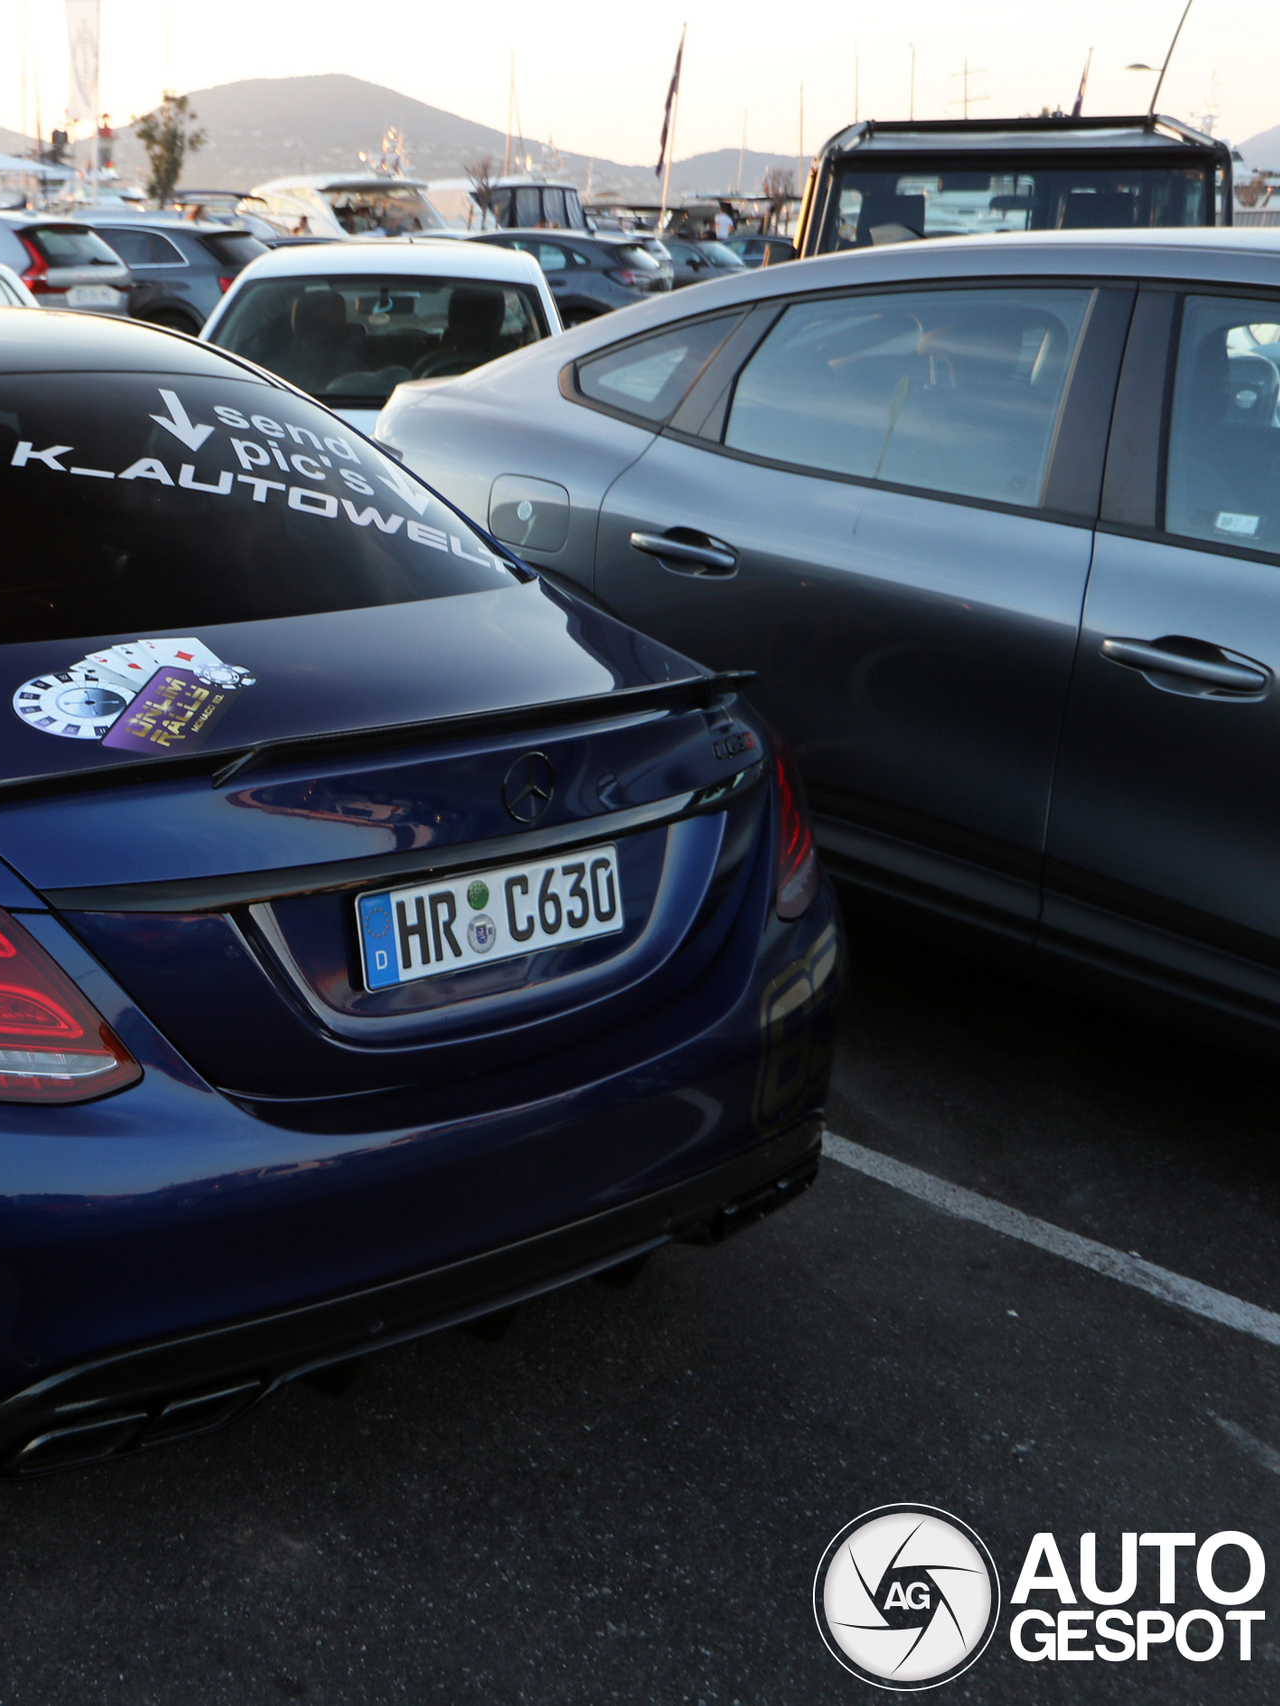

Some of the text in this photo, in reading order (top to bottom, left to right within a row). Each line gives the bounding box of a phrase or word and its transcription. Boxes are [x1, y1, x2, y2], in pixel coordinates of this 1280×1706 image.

[213, 405, 361, 465] send
[229, 436, 374, 496] pic's
[11, 441, 517, 574] K_AUTOWELT
[395, 857, 617, 969] HR C630
[375, 950, 388, 970] D
